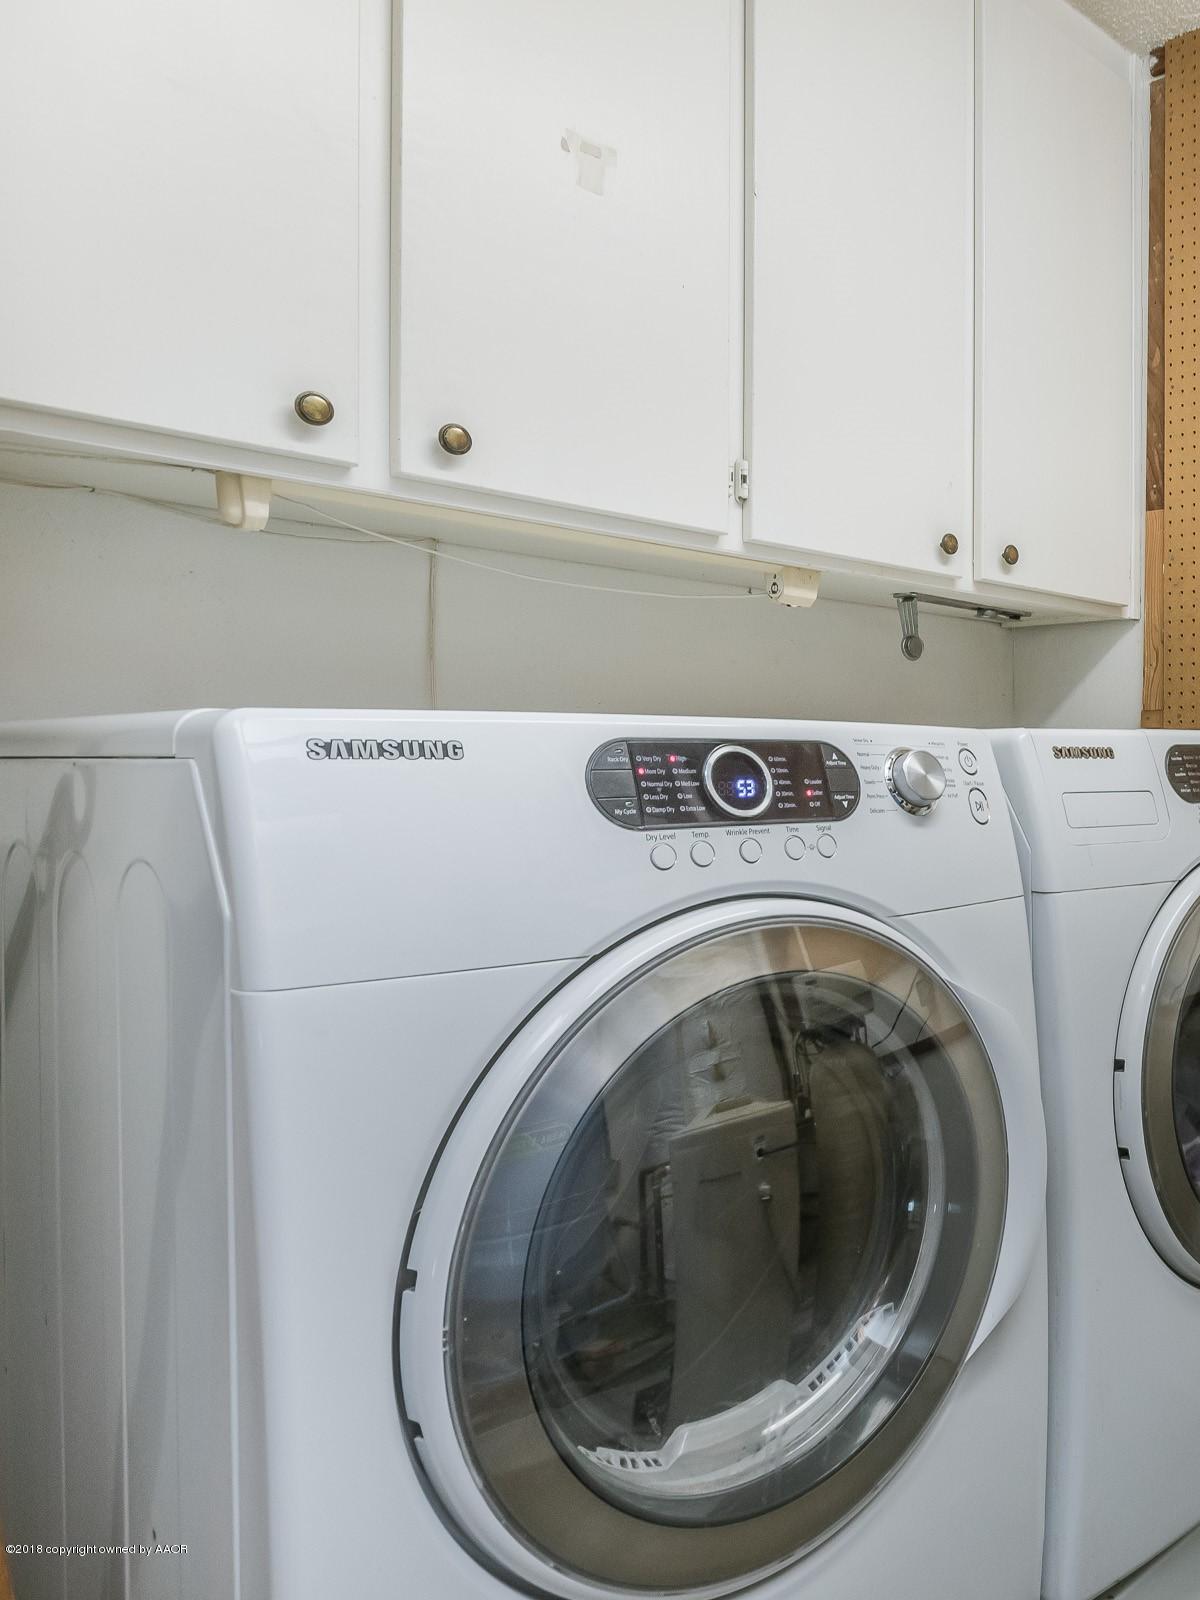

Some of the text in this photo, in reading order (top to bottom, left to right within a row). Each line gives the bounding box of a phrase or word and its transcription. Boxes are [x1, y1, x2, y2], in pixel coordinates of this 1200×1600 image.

[306, 738, 464, 760] SAMSUNG
[1052, 746, 1115, 759] SAMSUNG
[737, 779, 755, 797] 53
[646, 832, 676, 842] Dry Level
[749, 827, 770, 835] Prevent
